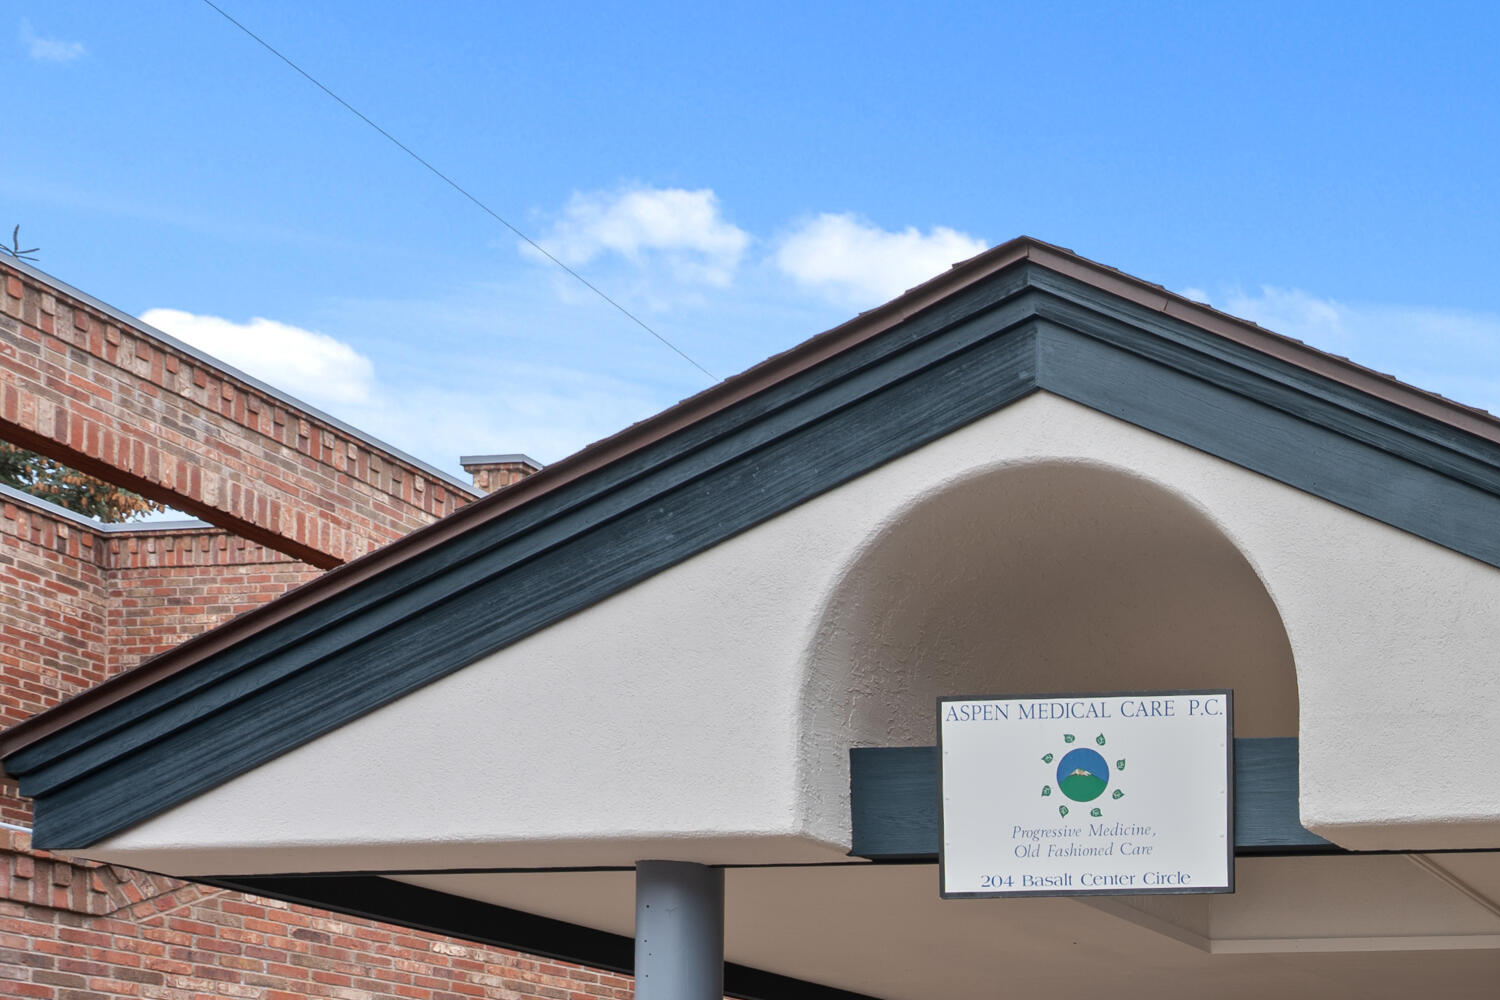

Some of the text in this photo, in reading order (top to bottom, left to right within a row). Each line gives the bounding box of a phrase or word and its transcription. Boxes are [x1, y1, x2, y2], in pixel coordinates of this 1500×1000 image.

[945, 699, 1223, 722] ASPEN MEDICAL CARE P.C.
[1012, 823, 1157, 843] Progressive Medicine,
[1014, 842, 1153, 859] Old Fashioned Care
[980, 871, 1191, 888] 204 Basalt Center Circle
